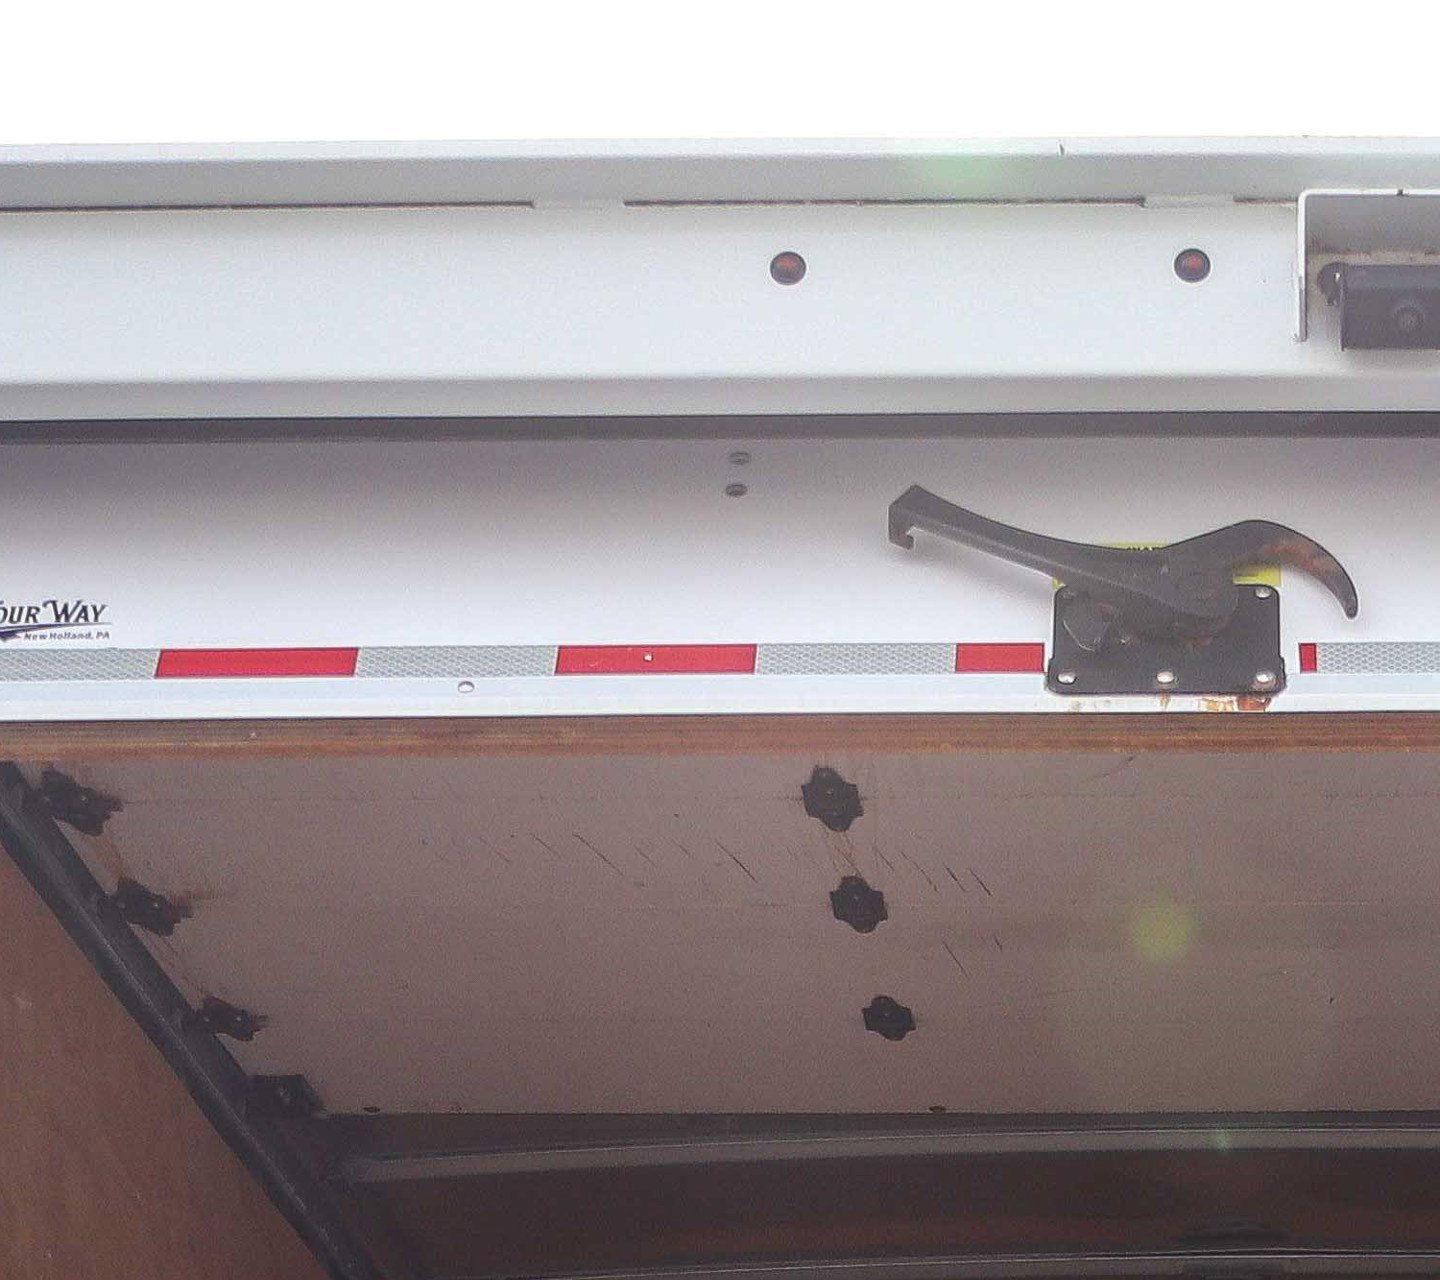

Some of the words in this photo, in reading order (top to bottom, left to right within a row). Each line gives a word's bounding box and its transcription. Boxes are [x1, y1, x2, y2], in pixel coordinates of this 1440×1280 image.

[43, 599, 109, 623] WAY
[23, 632, 48, 641] New
[95, 632, 110, 640] PA
